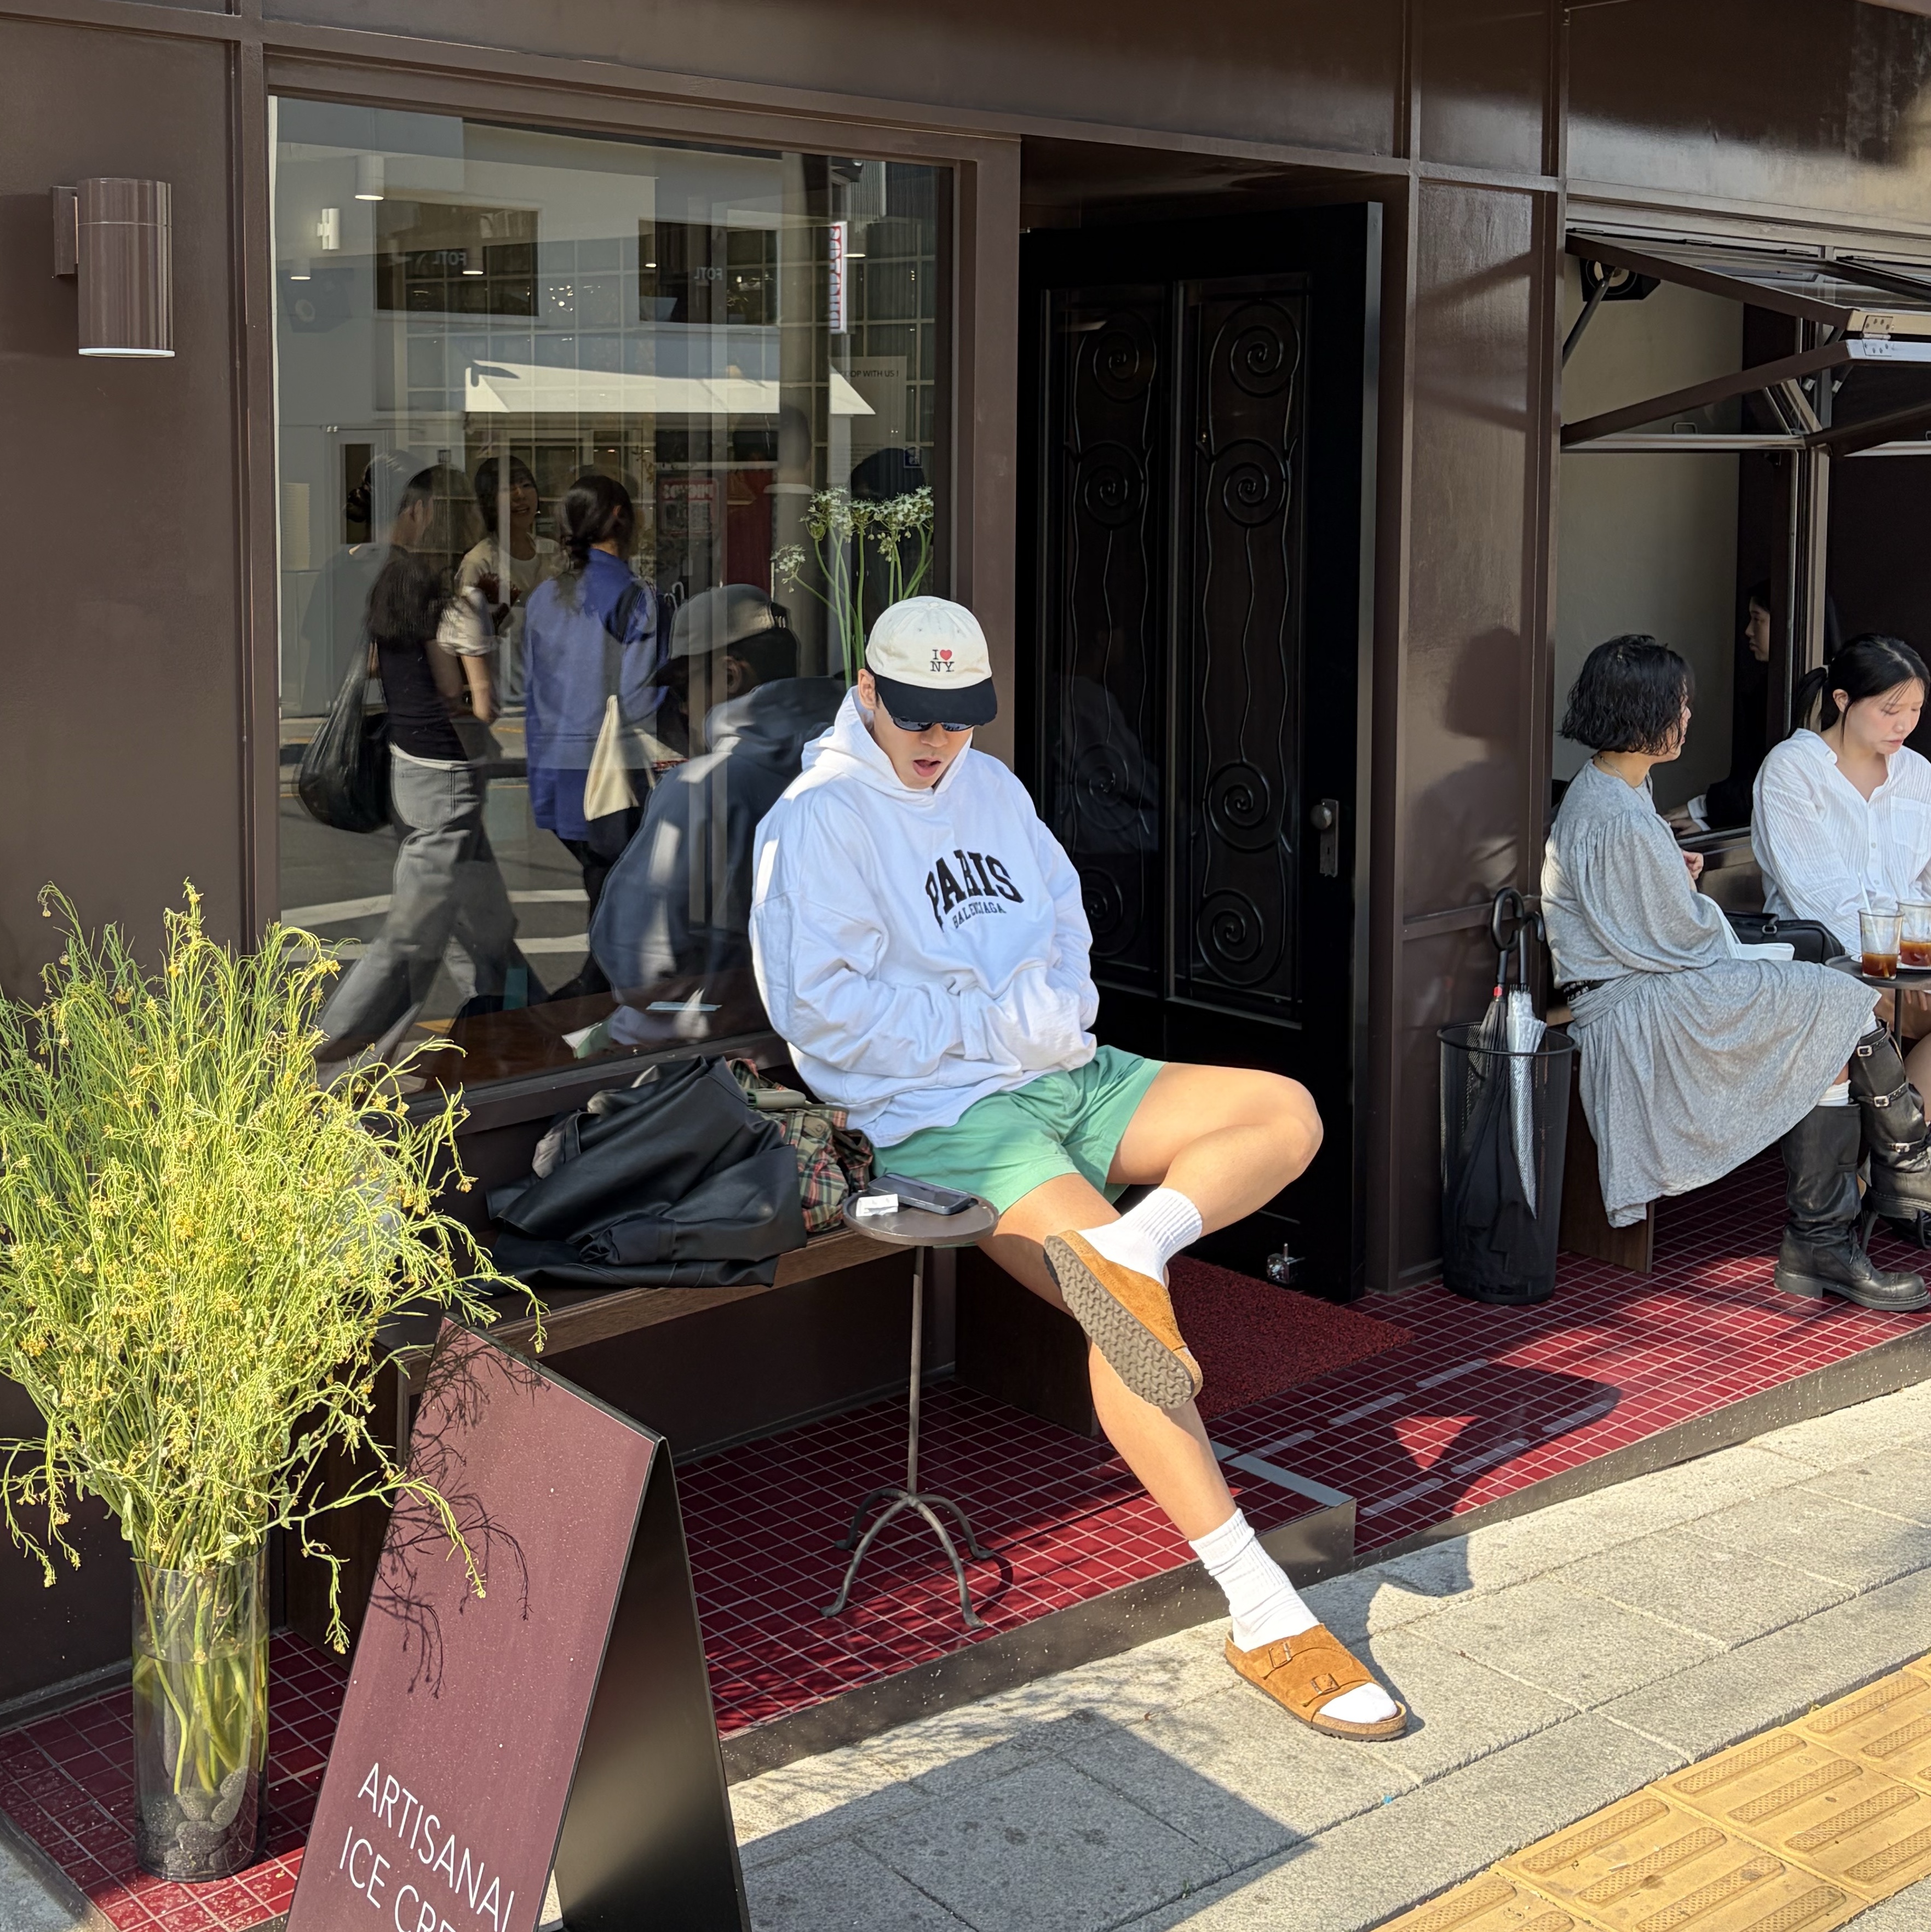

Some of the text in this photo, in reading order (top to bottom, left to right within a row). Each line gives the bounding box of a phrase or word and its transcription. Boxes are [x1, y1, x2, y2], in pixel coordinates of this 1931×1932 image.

[930, 661, 955, 673] NY
[926, 849, 1025, 933] PARIS
[952, 902, 1007, 929] BALEIAGA
[340, 1826, 456, 1932] ICE CR
